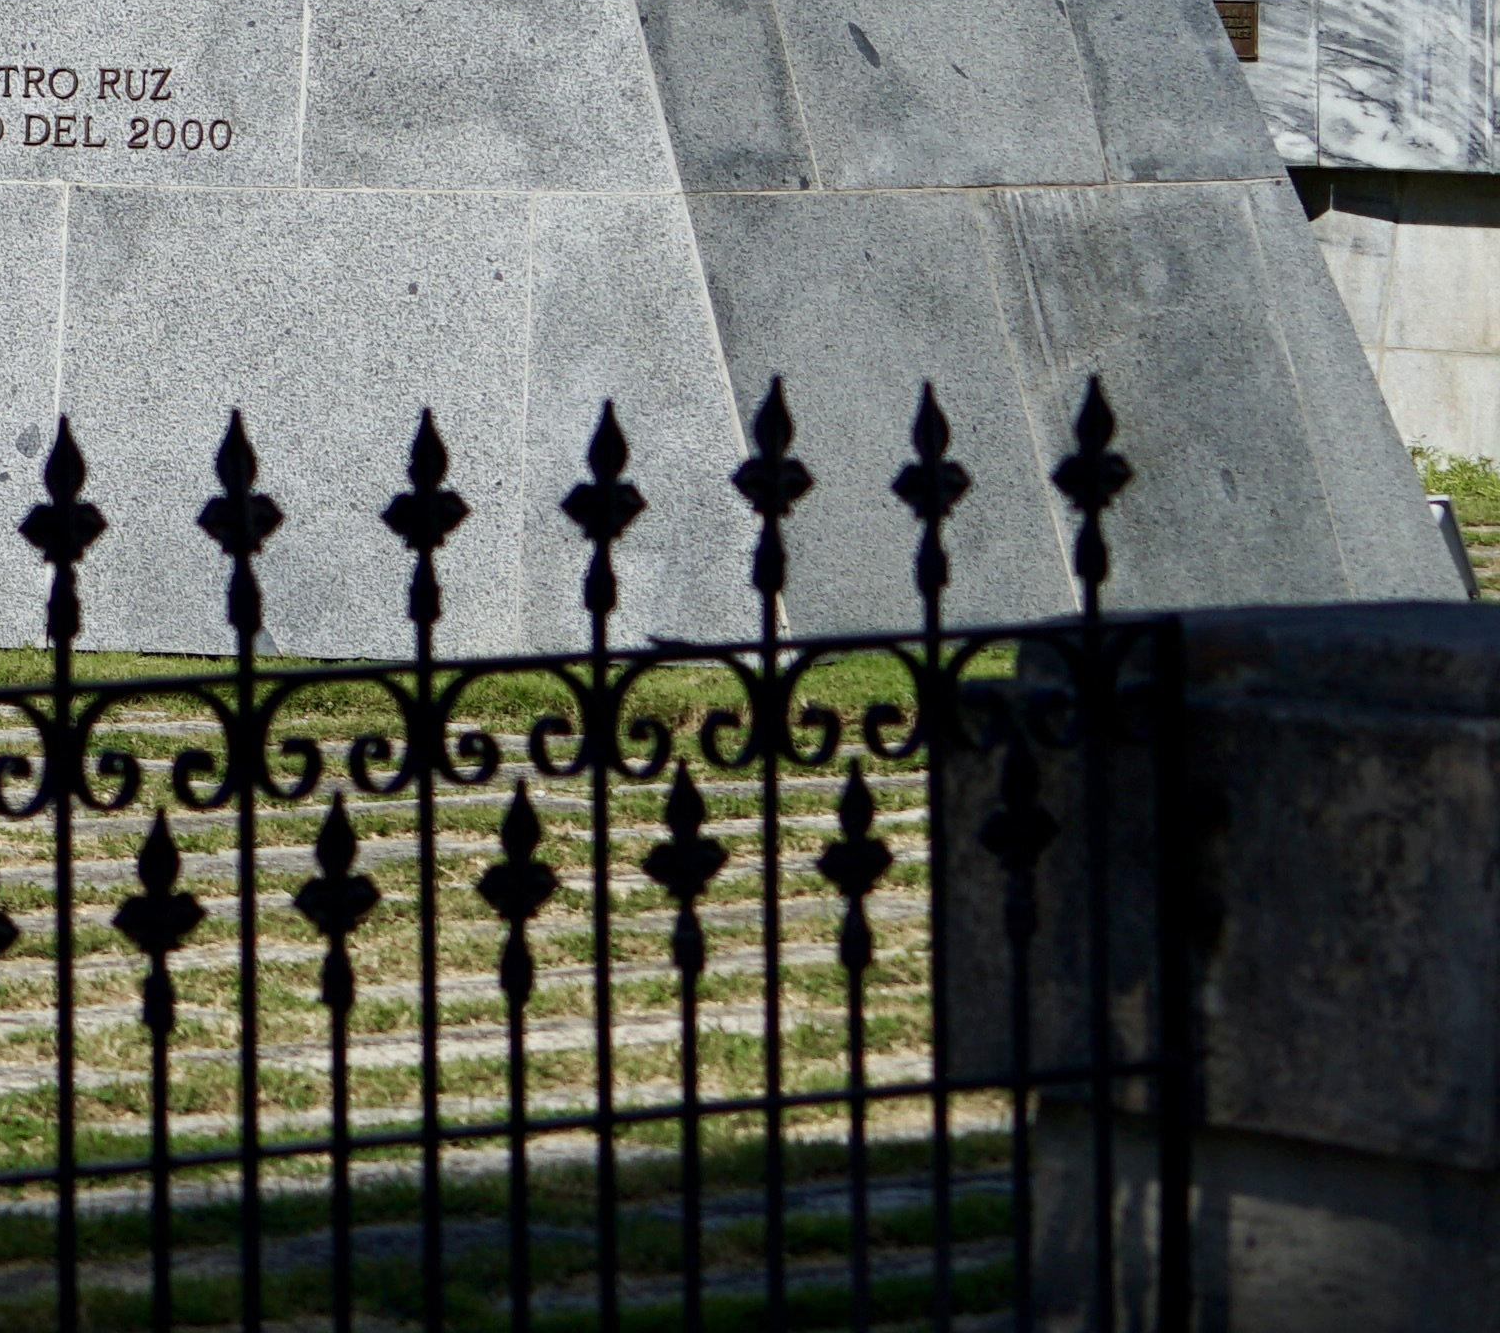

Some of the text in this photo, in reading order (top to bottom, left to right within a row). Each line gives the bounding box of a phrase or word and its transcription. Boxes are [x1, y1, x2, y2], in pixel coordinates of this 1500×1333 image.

[96, 67, 173, 103] RUZ
[21, 115, 107, 149] DEL
[121, 117, 233, 151] 2000
